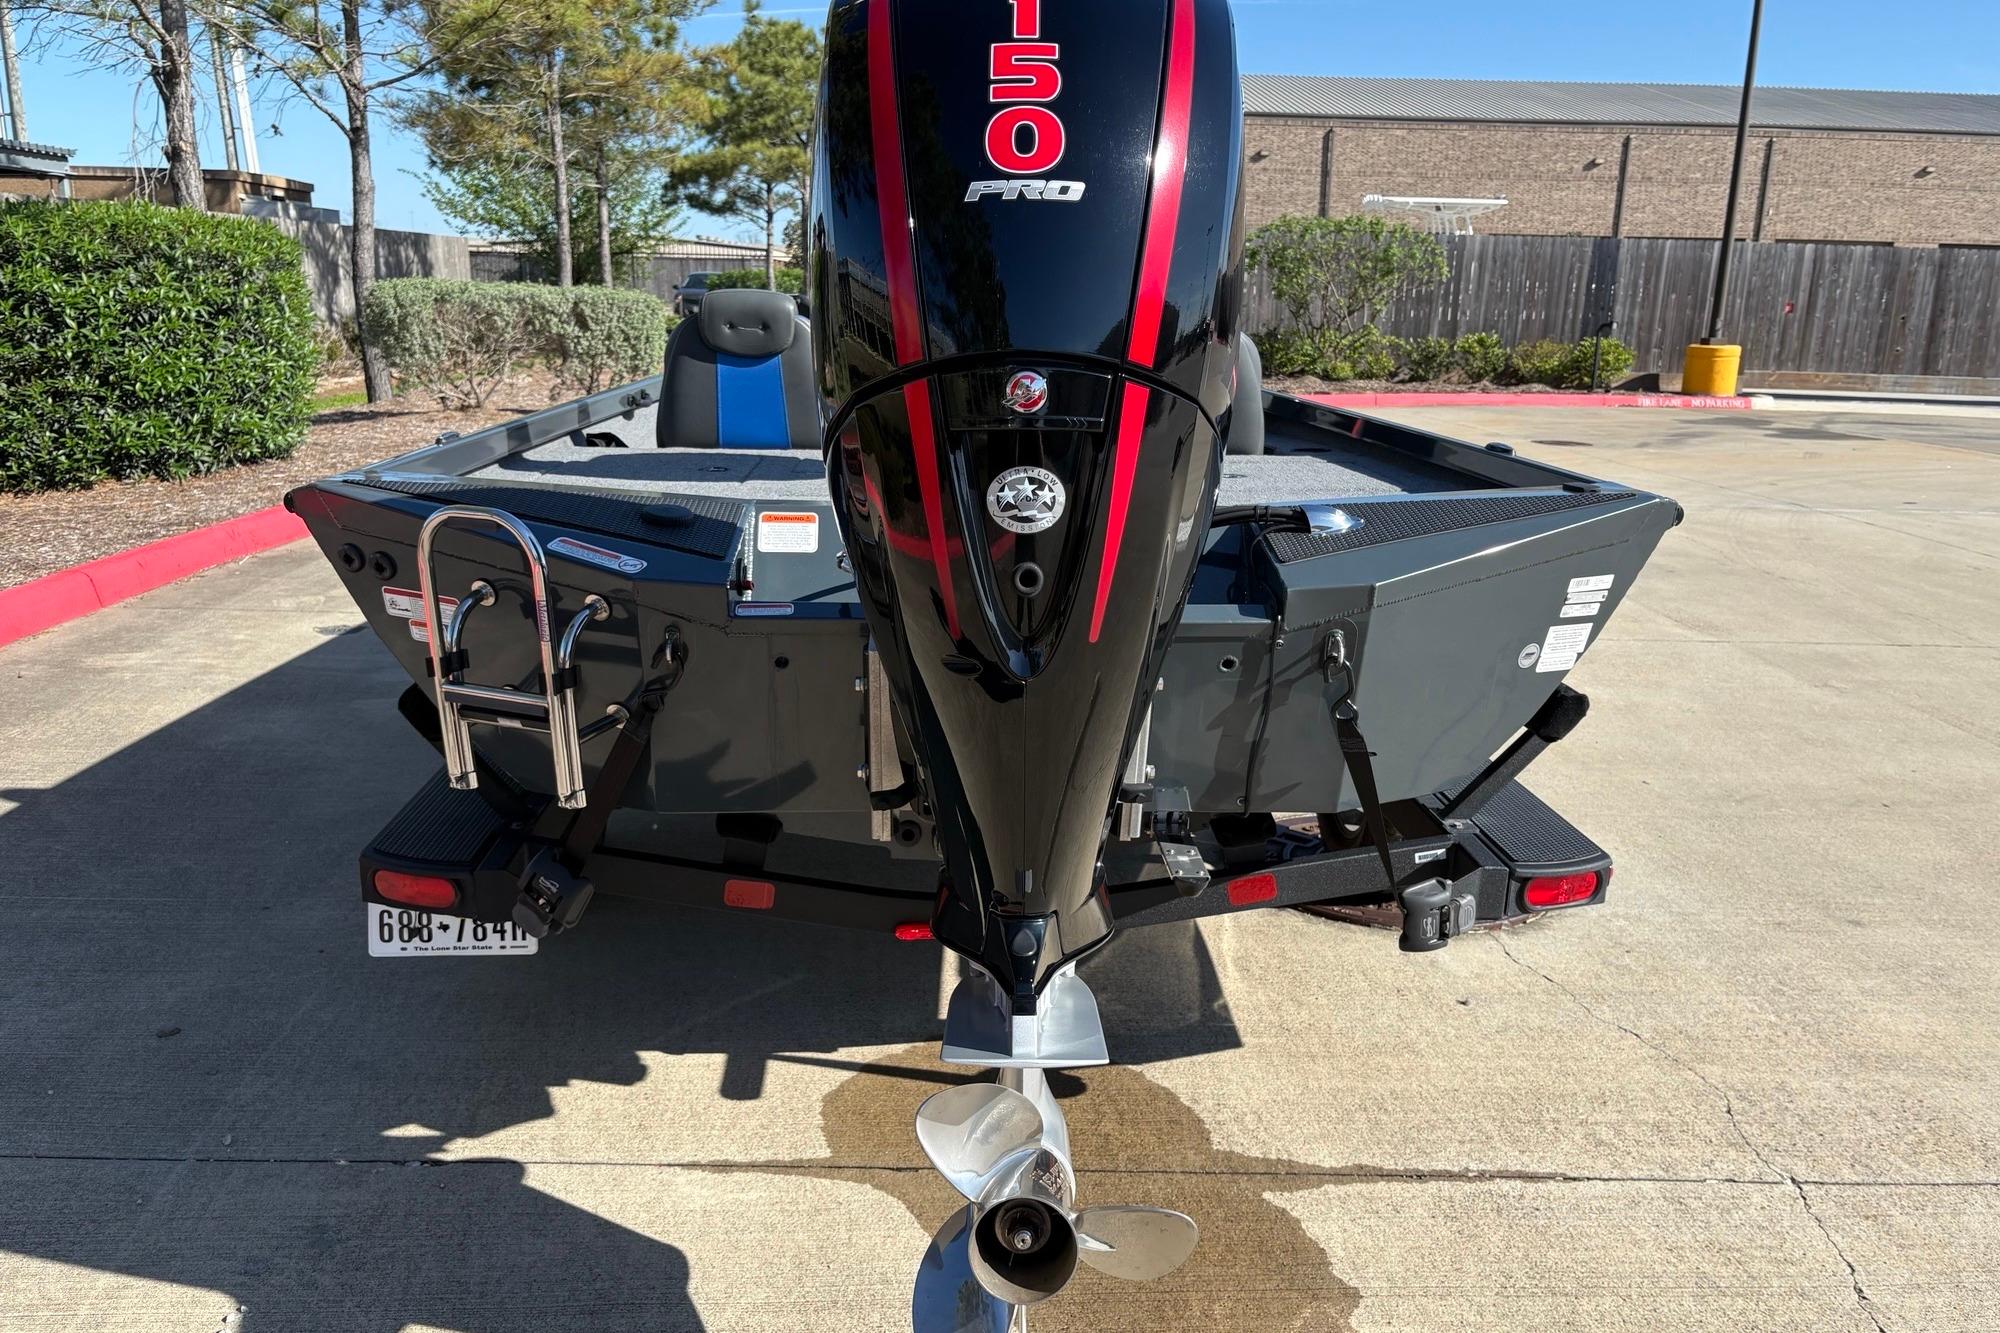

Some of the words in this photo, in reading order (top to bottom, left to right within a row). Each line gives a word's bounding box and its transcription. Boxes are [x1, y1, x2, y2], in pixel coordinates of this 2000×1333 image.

[985, 0, 1066, 174] 150
[964, 179, 1087, 202] PRO
[1691, 399, 1706, 408] NO
[995, 467, 1029, 486] ULTRA
[1037, 469, 1059, 487] LOW
[378, 909, 434, 943] 688
